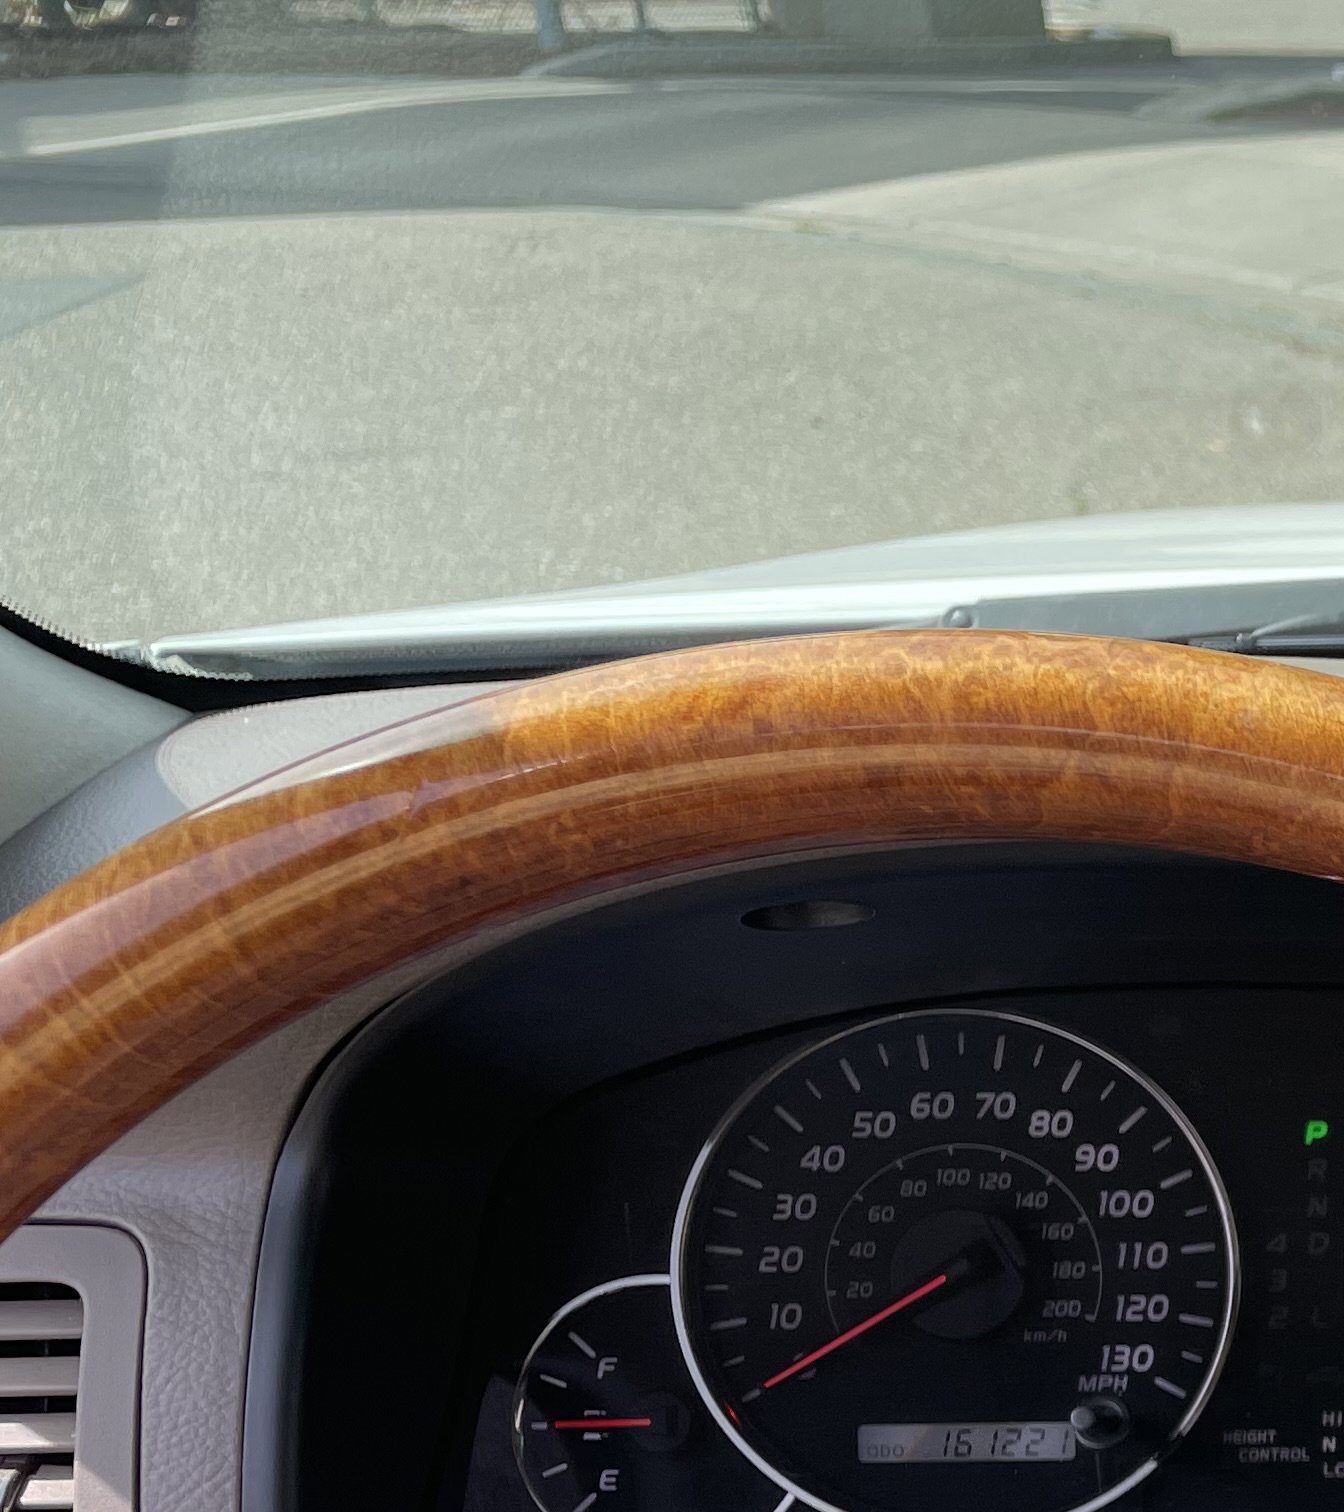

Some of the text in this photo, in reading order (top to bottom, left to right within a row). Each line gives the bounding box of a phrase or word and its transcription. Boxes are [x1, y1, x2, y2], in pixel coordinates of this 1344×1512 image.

[911, 1091, 955, 1119] 60
[975, 1091, 1017, 1120] 70
[852, 1111, 897, 1139] 50
[1028, 1109, 1074, 1138] 80
[1304, 1119, 1329, 1146] P
[800, 1145, 846, 1172] 40
[1074, 1143, 1120, 1172] 90
[936, 1167, 971, 1187] 100
[979, 1171, 1012, 1191] 120
[900, 1179, 928, 1198] 80
[772, 1193, 818, 1222] 30
[1015, 1191, 1049, 1210] 140
[1099, 1189, 1155, 1218] 100
[868, 1205, 895, 1224] 60
[1041, 1222, 1075, 1241] 160
[758, 1245, 804, 1273] 20
[849, 1241, 877, 1260] 40
[1117, 1241, 1169, 1270] 110
[1052, 1261, 1086, 1280] 180
[846, 1281, 873, 1299] 20
[769, 1303, 803, 1331] 10
[1042, 1299, 1082, 1319] 200
[1116, 1294, 1170, 1322] 120
[1023, 1323, 1068, 1343] km/h
[596, 1356, 619, 1380] F
[1100, 1344, 1155, 1372] 130
[1077, 1374, 1129, 1393] MPH
[1321, 1409, 1343, 1428] HI
[1222, 1428, 1278, 1445] HEIGHT
[1321, 1435, 1338, 1454] N
[1238, 1446, 1311, 1464] CONTROL
[599, 1468, 621, 1492] E
